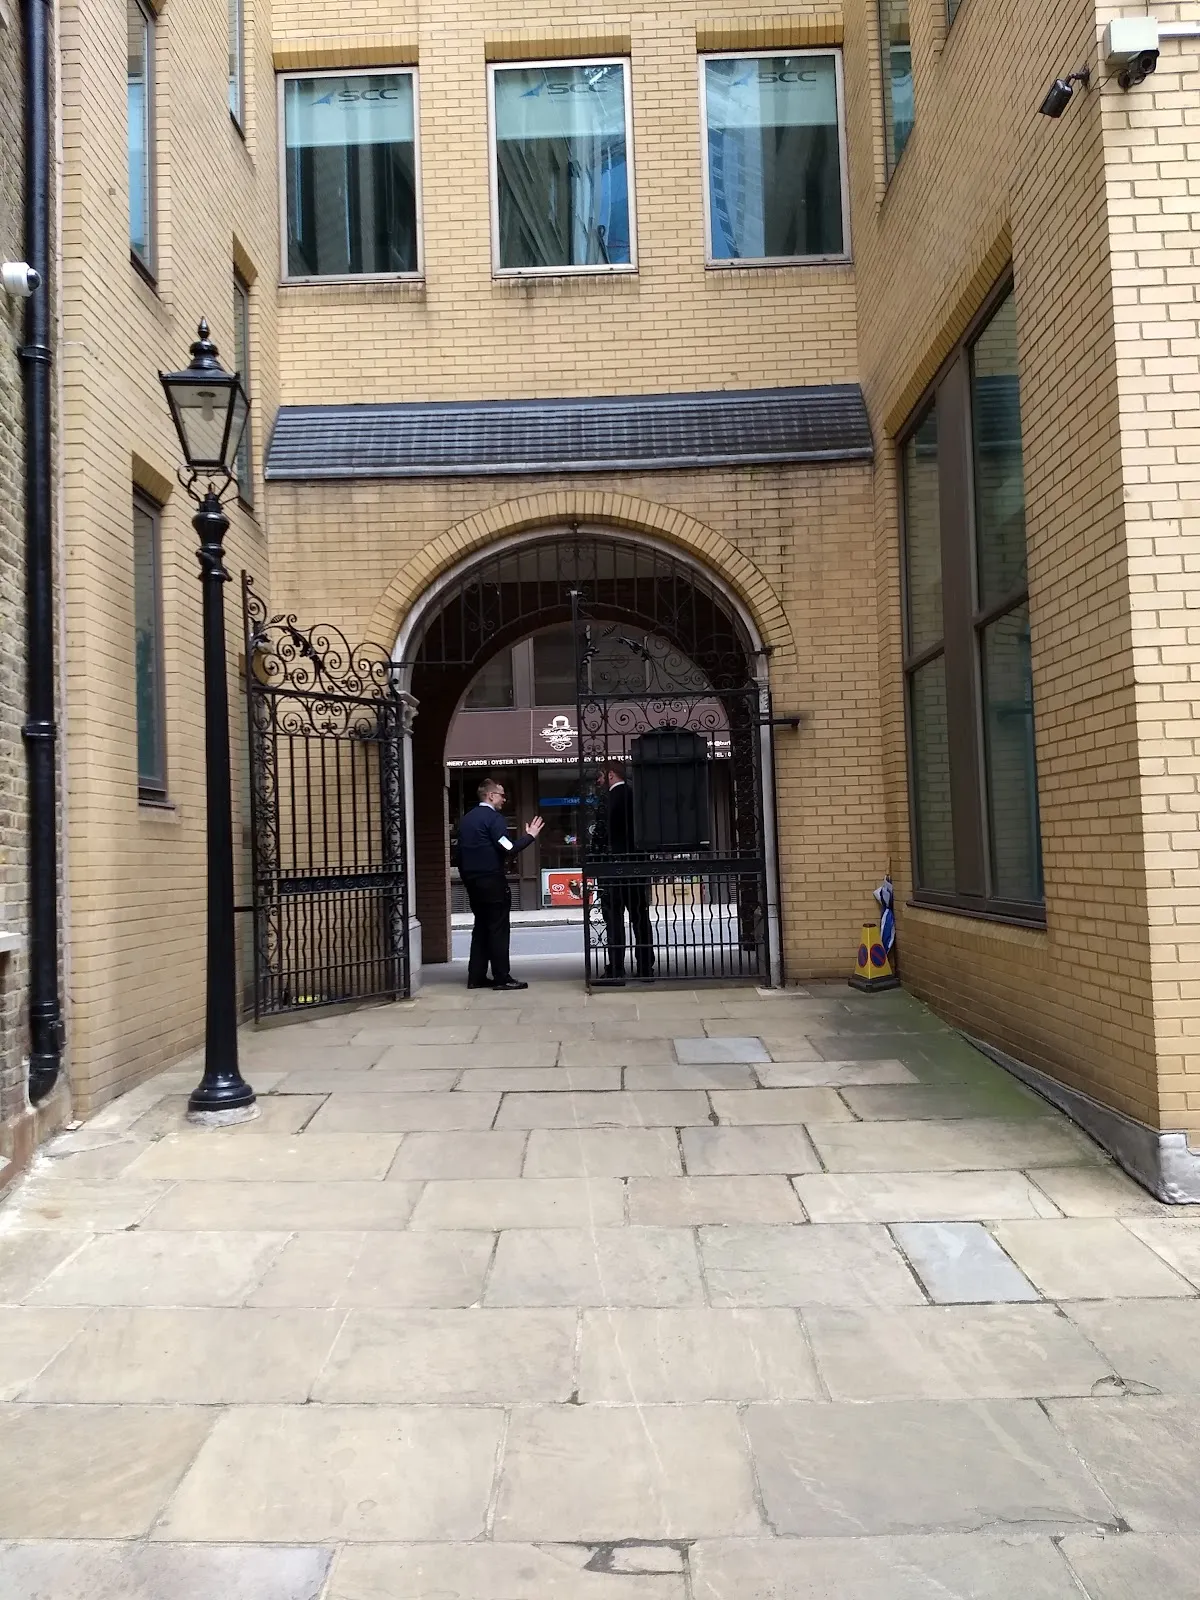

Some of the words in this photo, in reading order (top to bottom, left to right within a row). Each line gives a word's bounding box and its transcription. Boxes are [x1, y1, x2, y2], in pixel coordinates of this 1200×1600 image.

[758, 70, 817, 84] SCC
[547, 81, 609, 95] SCC
[338, 88, 399, 103] SCC
